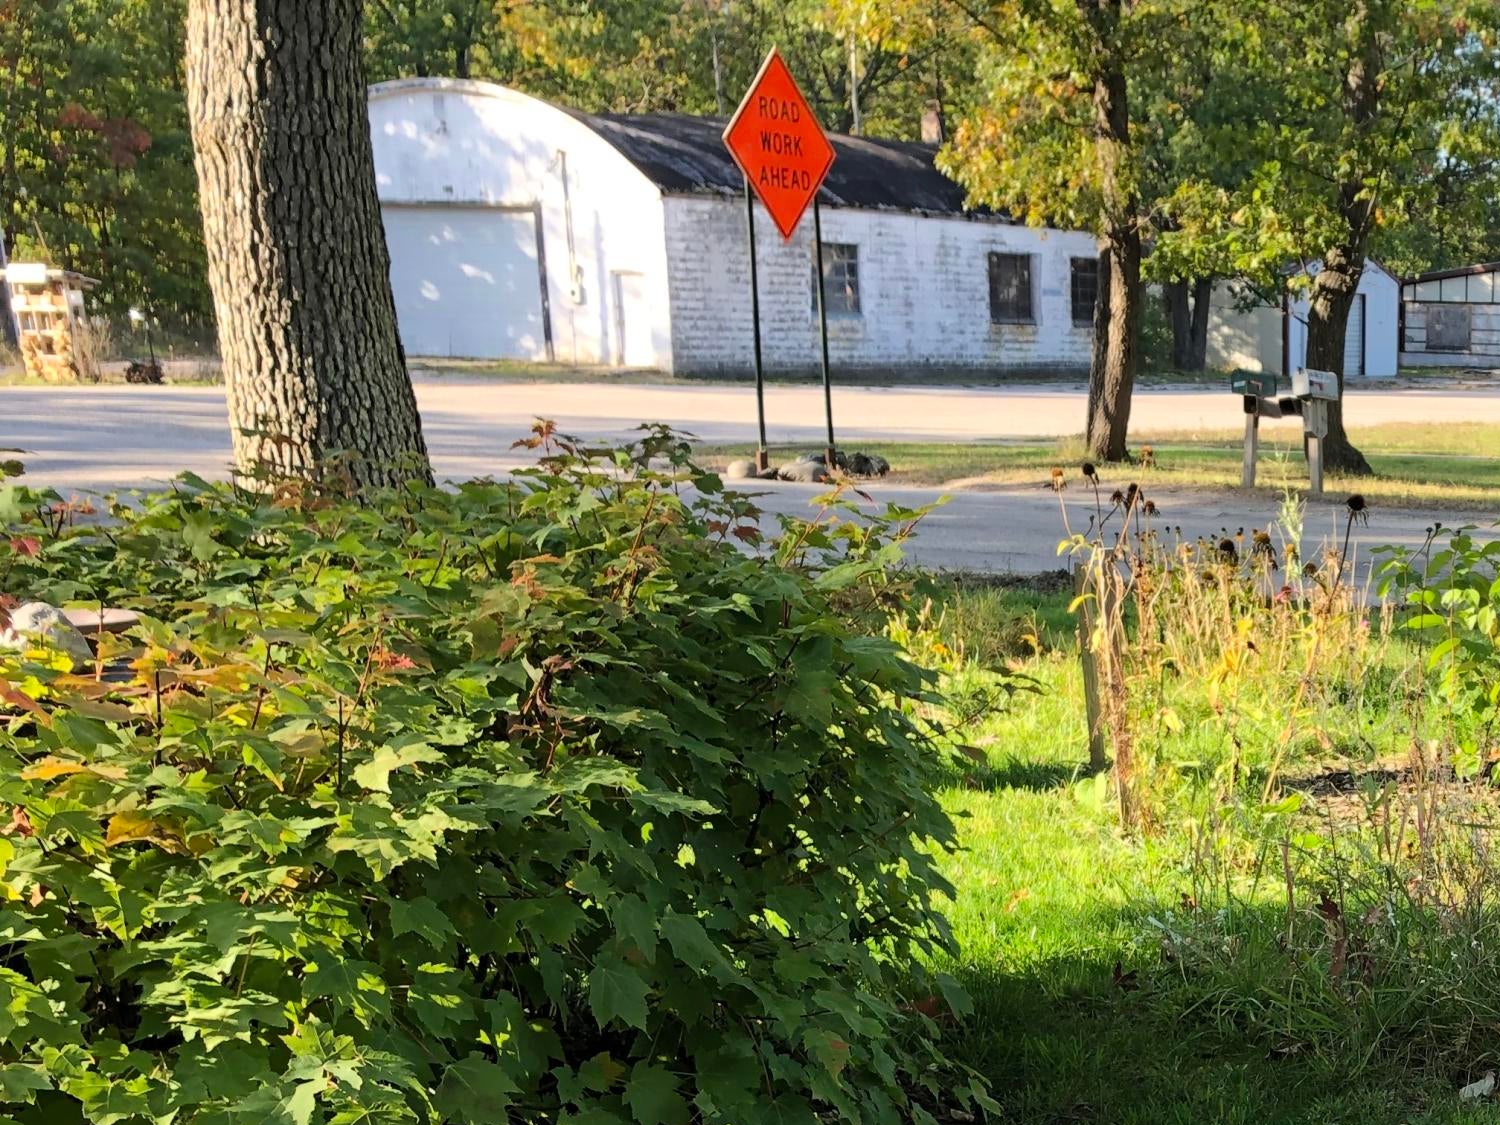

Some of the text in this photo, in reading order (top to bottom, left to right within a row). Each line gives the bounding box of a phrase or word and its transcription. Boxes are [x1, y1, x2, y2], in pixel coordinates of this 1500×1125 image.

[759, 96, 800, 123] ROAD
[760, 130, 803, 158] WORK
[760, 165, 811, 191] AHEAD
